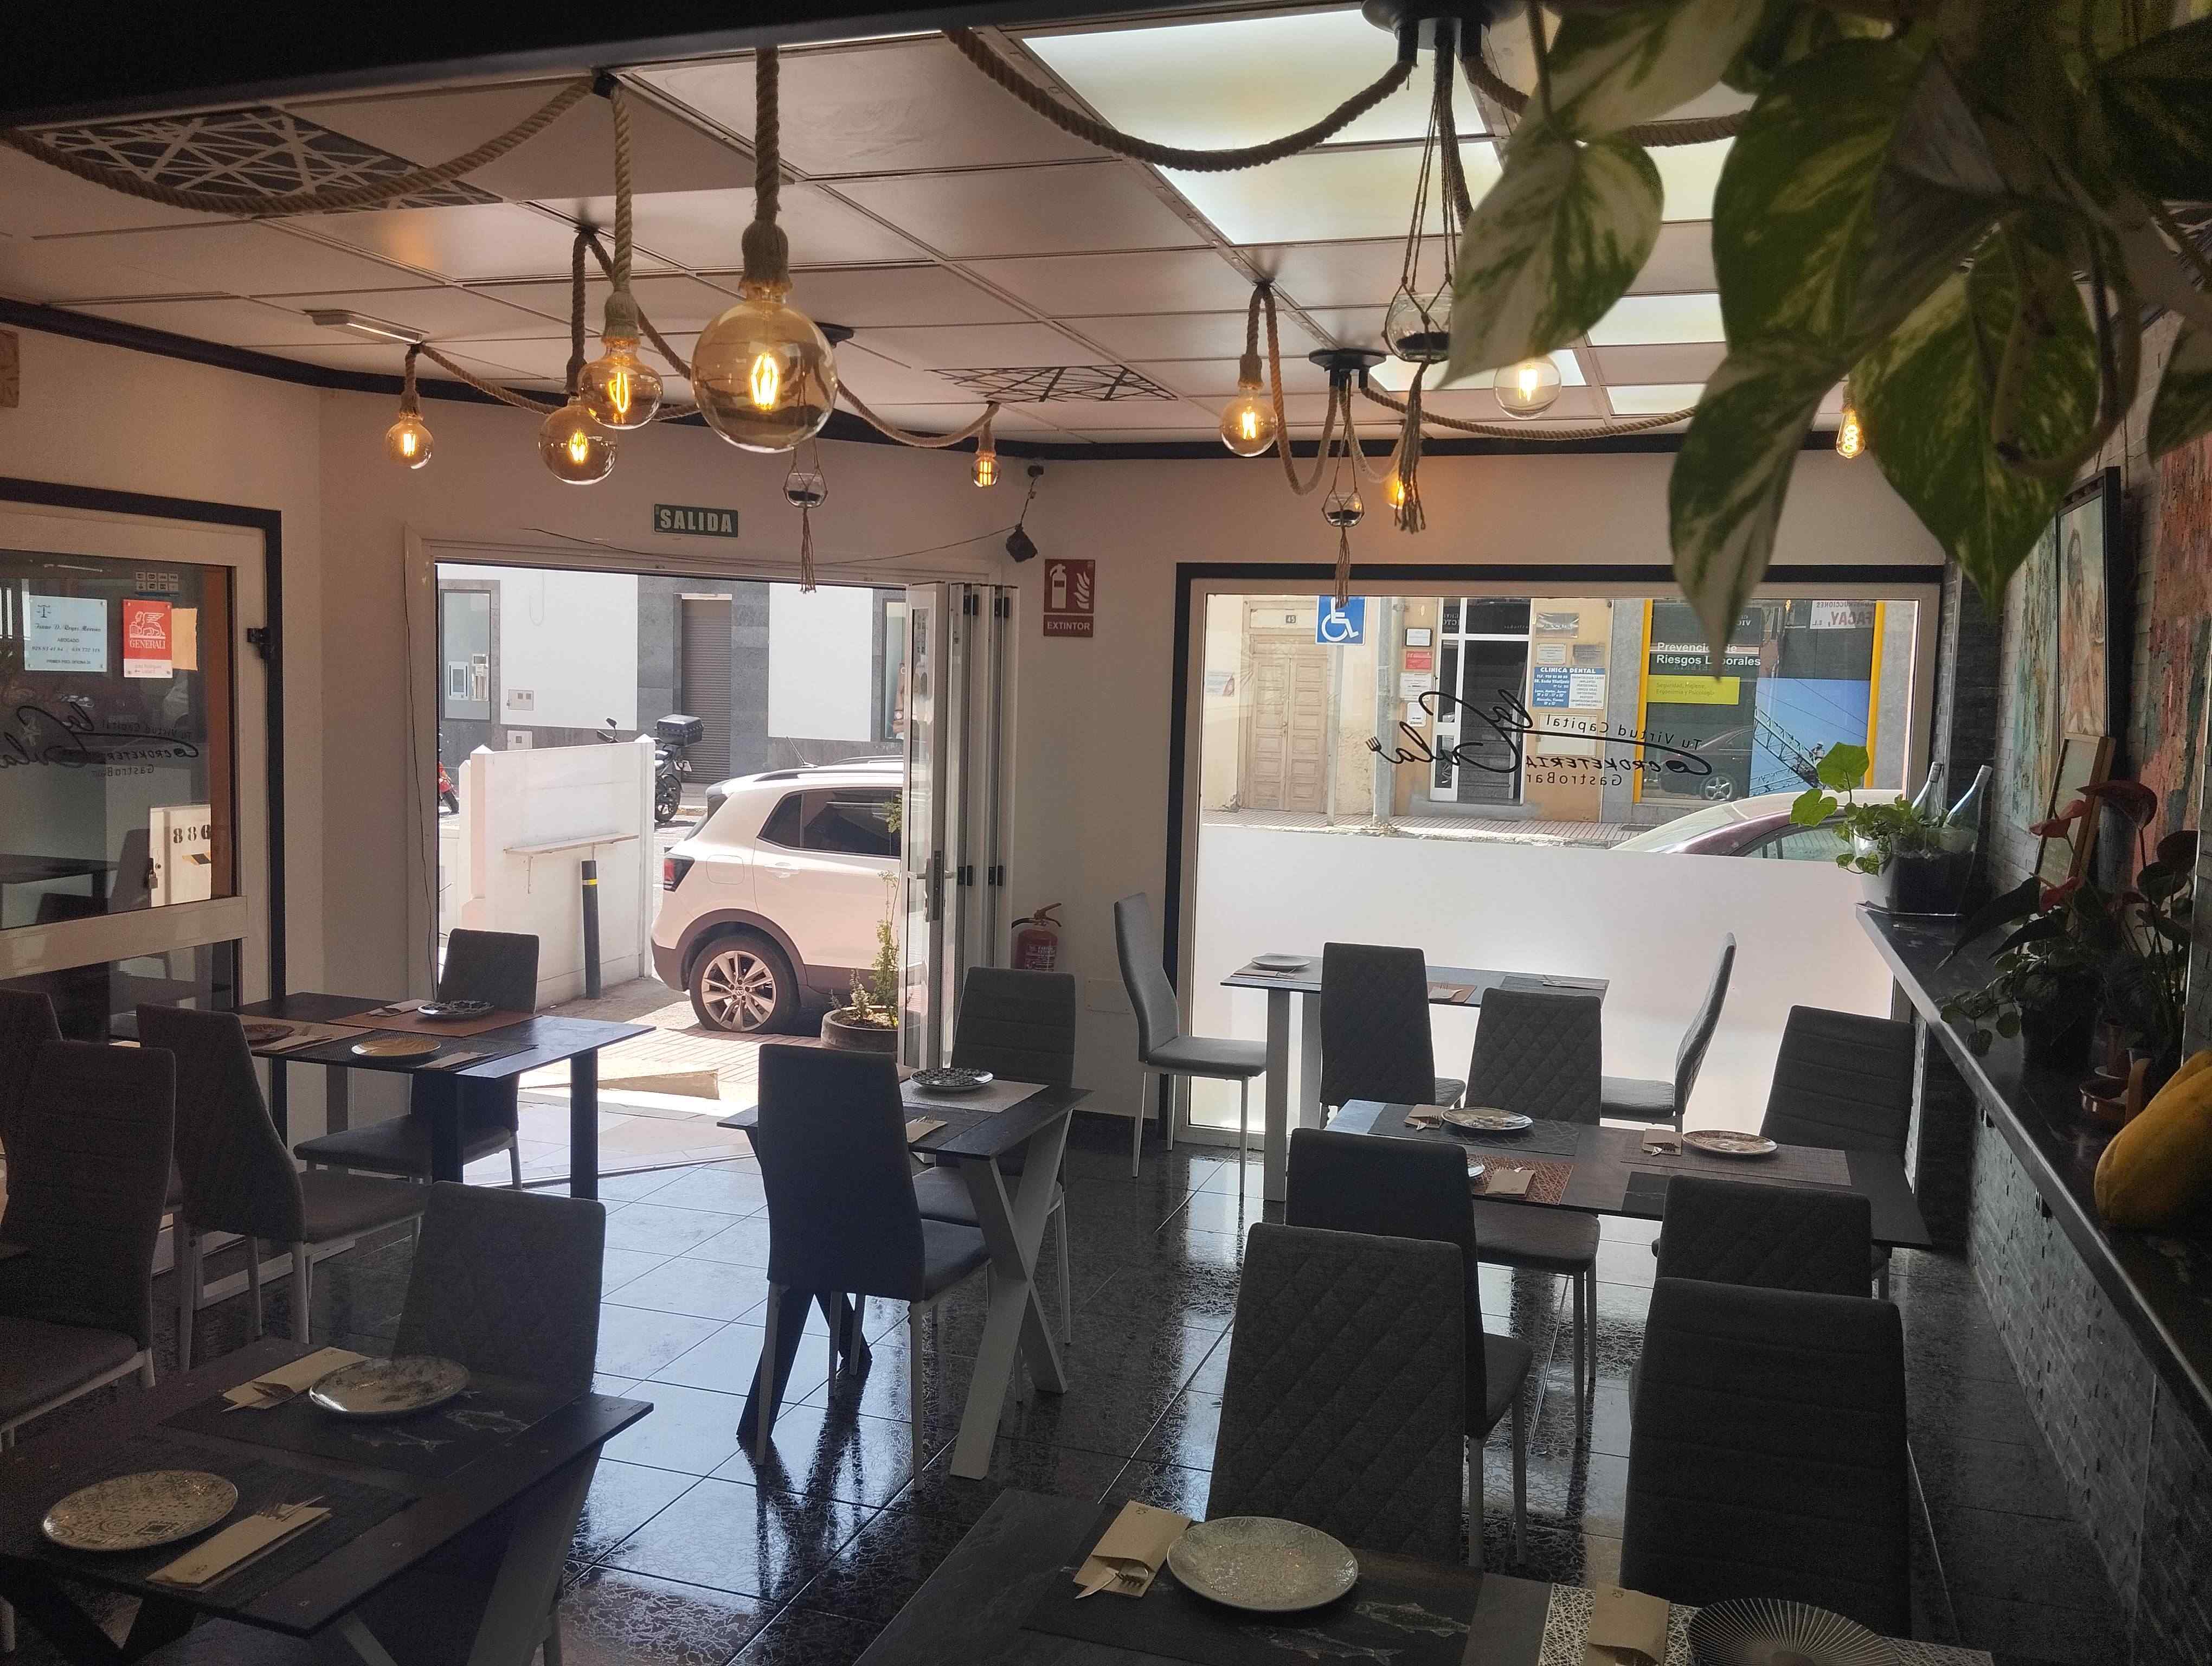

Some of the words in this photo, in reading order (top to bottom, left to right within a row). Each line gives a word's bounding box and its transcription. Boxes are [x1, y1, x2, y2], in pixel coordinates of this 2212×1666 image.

[660, 509, 732, 533] SALIDA
[1047, 621, 1090, 630] EXTINTOR
[130, 639, 165, 649] GENERALI
[1656, 654, 1702, 666] Riesgos
